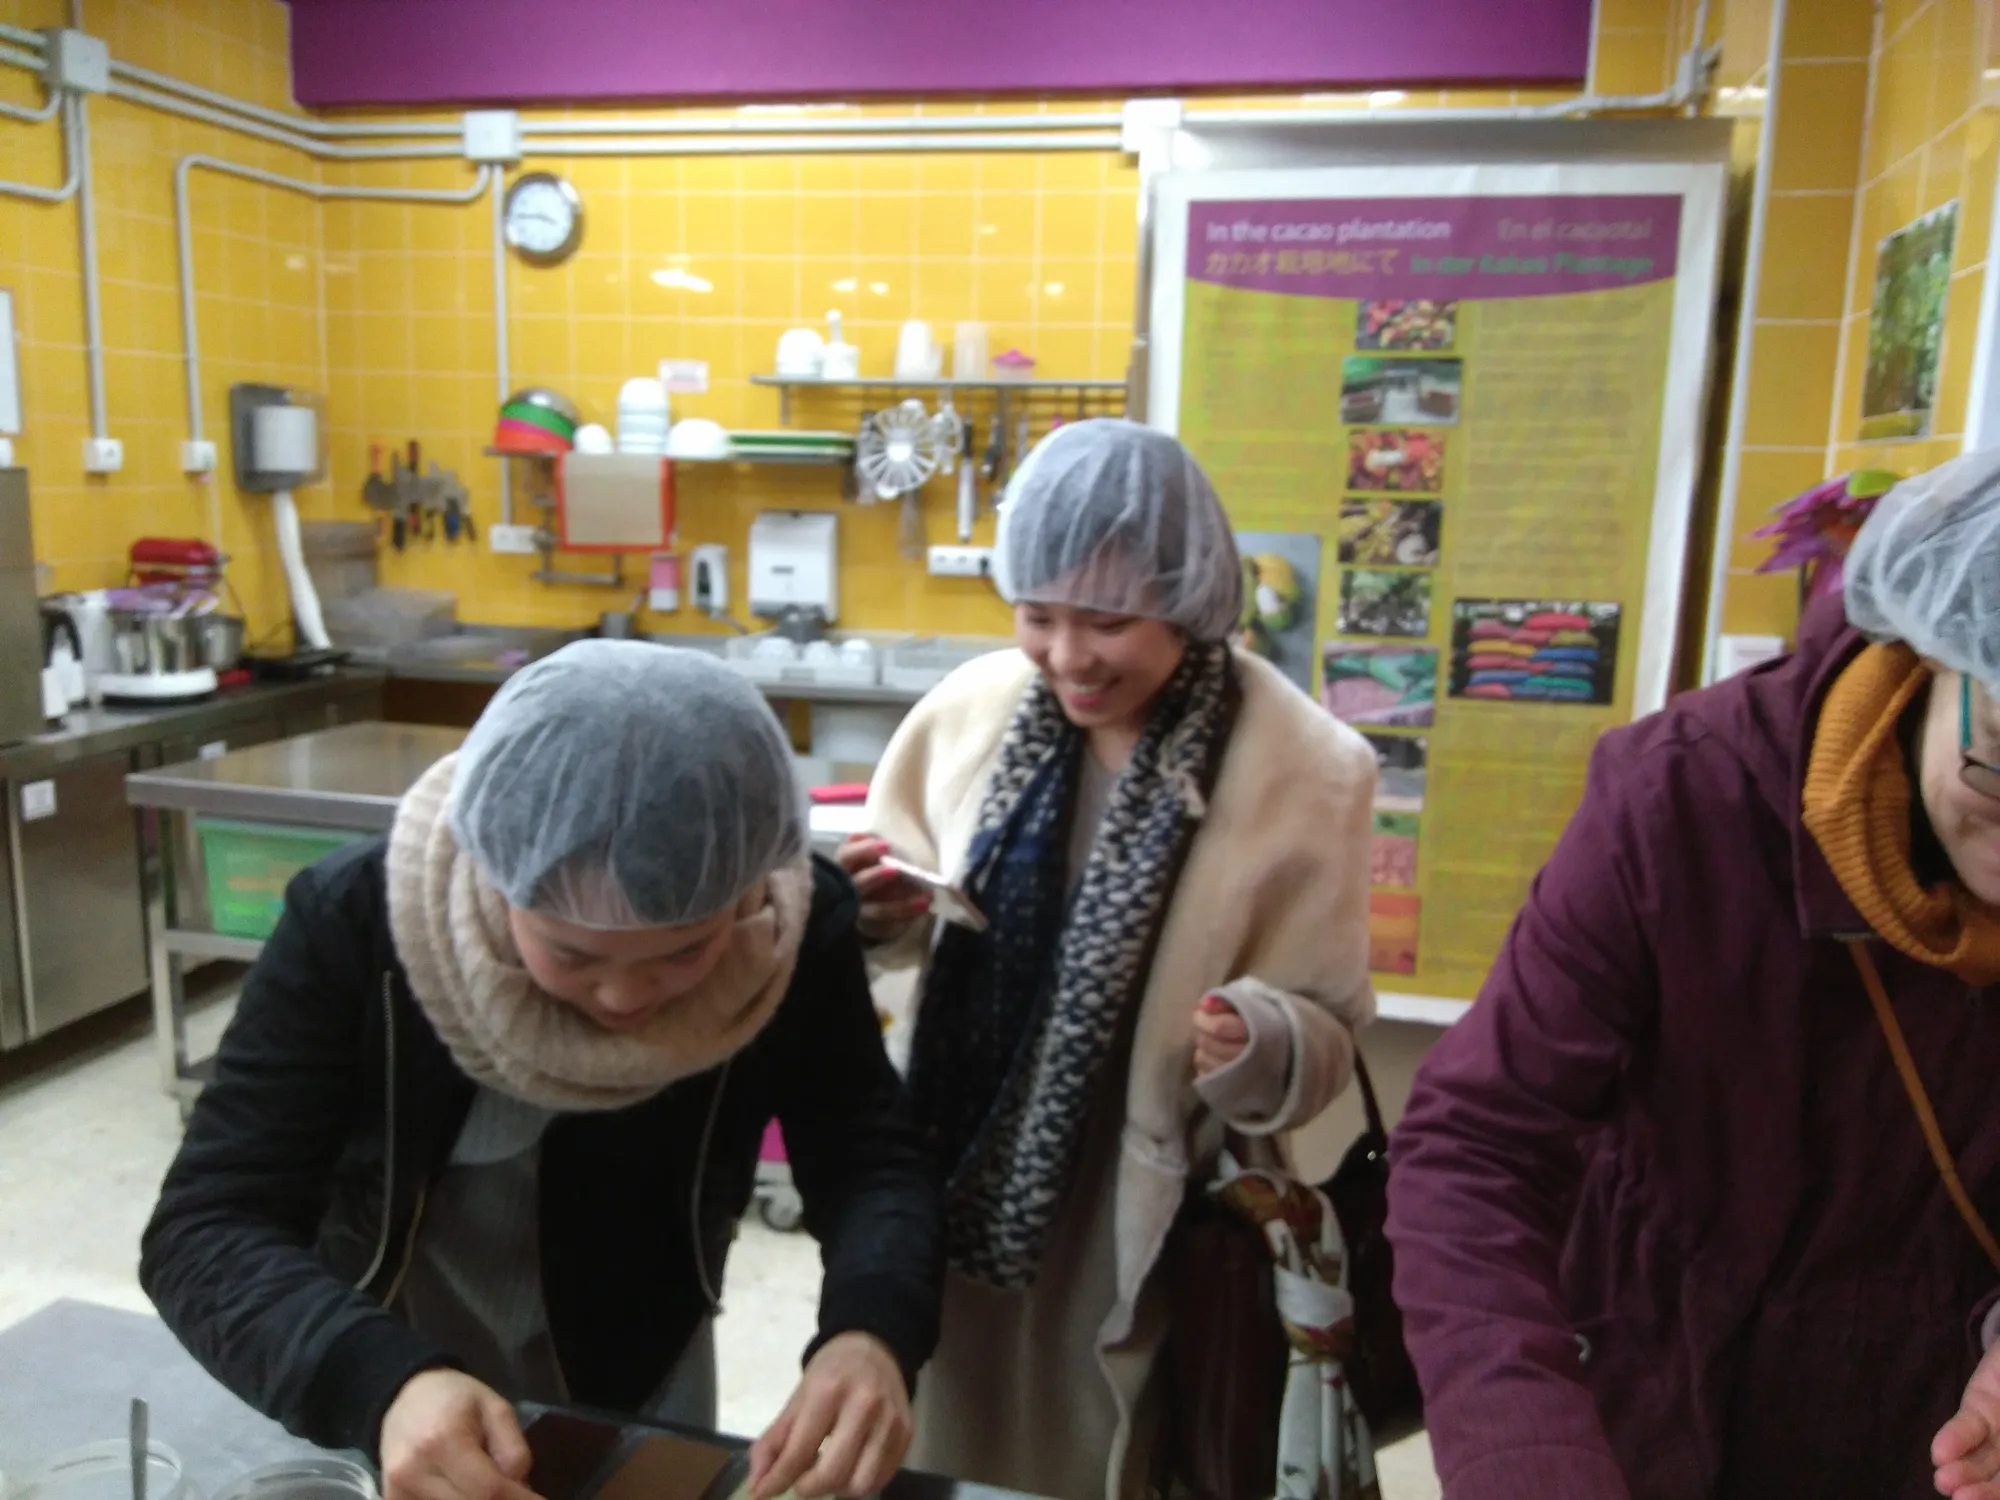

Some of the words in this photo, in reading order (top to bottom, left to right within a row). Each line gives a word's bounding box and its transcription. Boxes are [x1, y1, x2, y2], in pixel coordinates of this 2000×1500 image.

[1205, 220, 1229, 242] In
[1231, 218, 1268, 242] the
[1270, 222, 1334, 242] cacao
[1336, 217, 1451, 245] plantation
